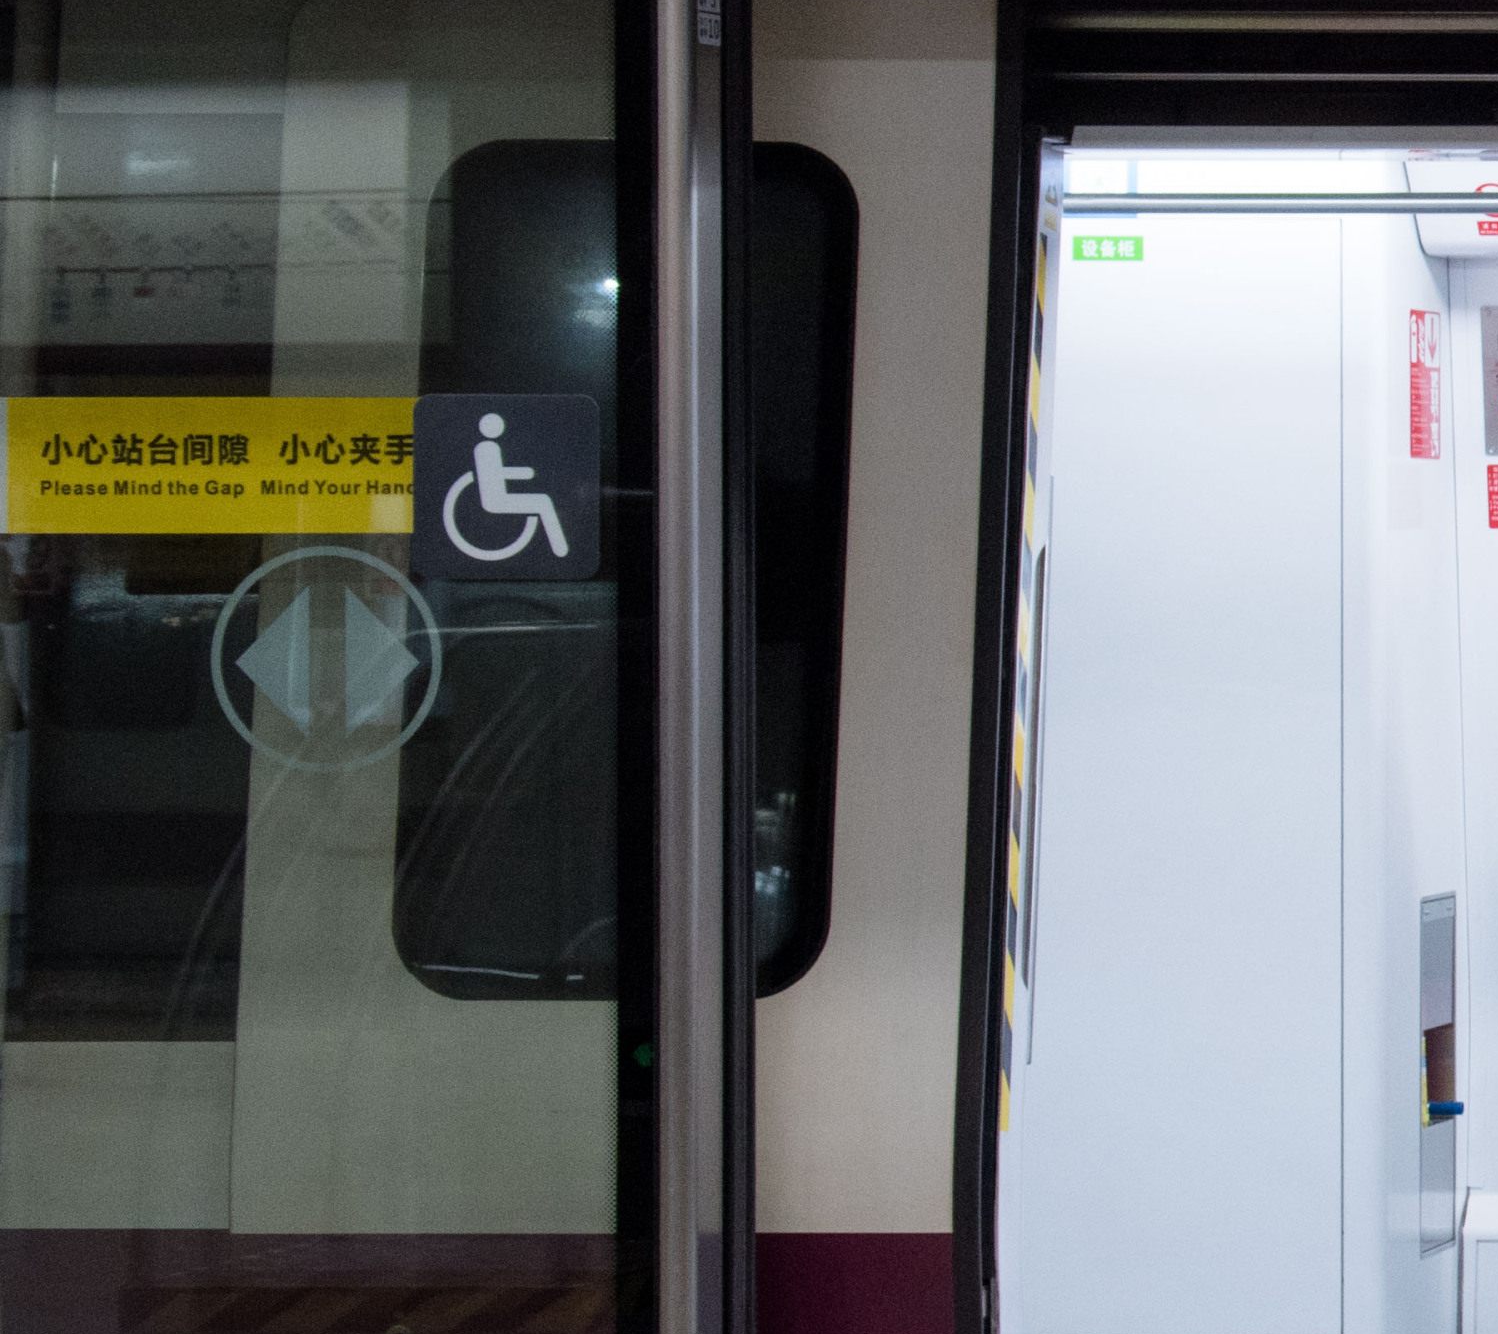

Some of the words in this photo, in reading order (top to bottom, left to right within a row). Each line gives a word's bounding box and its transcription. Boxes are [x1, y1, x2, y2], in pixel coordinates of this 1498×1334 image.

[41, 432, 250, 466] 小心站台间隙
[279, 432, 413, 466] 小心夹手
[40, 479, 109, 496] Please
[113, 479, 163, 496] Mind
[167, 479, 200, 496] the
[204, 479, 245, 500] Gap
[260, 479, 309, 496] Mind
[314, 479, 361, 496] Your
